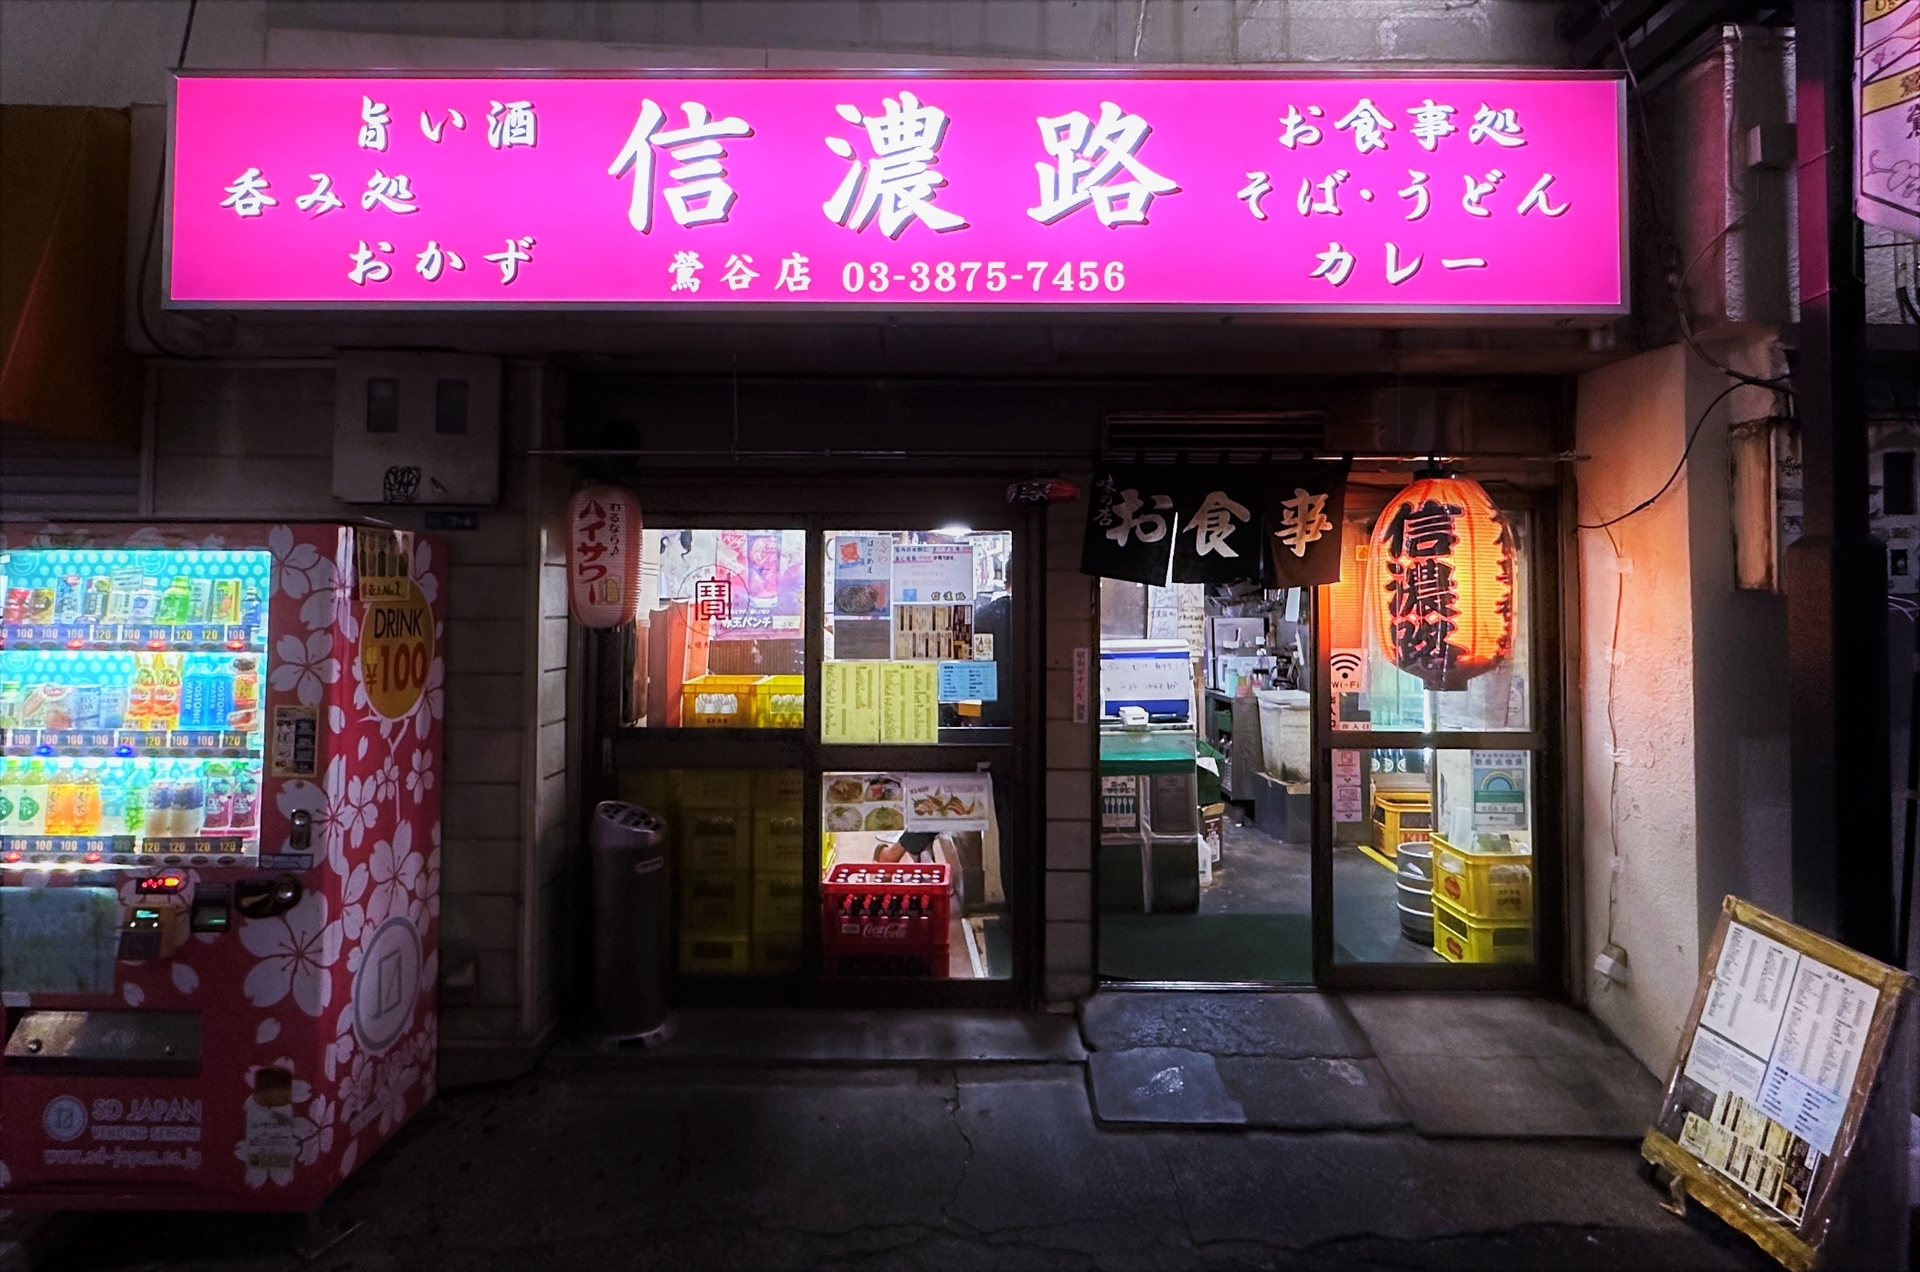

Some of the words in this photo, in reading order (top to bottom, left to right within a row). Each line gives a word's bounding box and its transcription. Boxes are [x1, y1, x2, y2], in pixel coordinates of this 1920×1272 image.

[357, 95, 539, 152] 旨い酒
[1277, 97, 1529, 154] お食事処
[606, 91, 1183, 240] 信濃路
[219, 167, 420, 220] 呑み処
[1237, 168, 1572, 221] そば・うどん
[346, 235, 538, 287] おかず
[1308, 241, 1489, 287] カレー
[667, 251, 812, 294] 鶯谷店
[841, 260, 1127, 293] 03-3875-7456
[1105, 488, 1333, 557] お食事
[577, 500, 608, 606] ハイサワー
[1382, 500, 1470, 672] 信濃路
[374, 608, 424, 639] DRINK
[17, 628, 33, 639] 100
[42, 628, 58, 639] 100
[67, 628, 84, 639] 100
[95, 628, 111, 640] 120
[124, 629, 140, 640] 100
[149, 629, 166, 640] 100
[176, 629, 193, 641] 120
[201, 629, 218, 641] 120
[228, 629, 245, 641] 100
[1331, 680, 1360, 689] Wi-Fi
[185, 681, 194, 710] WATER
[210, 681, 218, 710] WATER
[193, 680, 203, 724] POSTONIC
[216, 680, 226, 724] POSTONIC
[14, 734, 31, 745] 100
[41, 734, 58, 745] 100
[66, 735, 83, 746] 100
[91, 735, 108, 746] 100
[120, 735, 136, 747] 120
[145, 735, 161, 747] 120
[172, 735, 189, 747] 100
[197, 735, 214, 747] 100
[225, 735, 241, 747] 120
[10, 840, 27, 851] 100
[35, 840, 52, 851] 100
[61, 841, 78, 851] 100
[86, 841, 103, 851] 100
[144, 842, 160, 853] 120
[169, 842, 186, 853] 120
[194, 842, 211, 853] 120
[220, 841, 236, 852] 120
[126, 1096, 202, 1122] JAPAN
